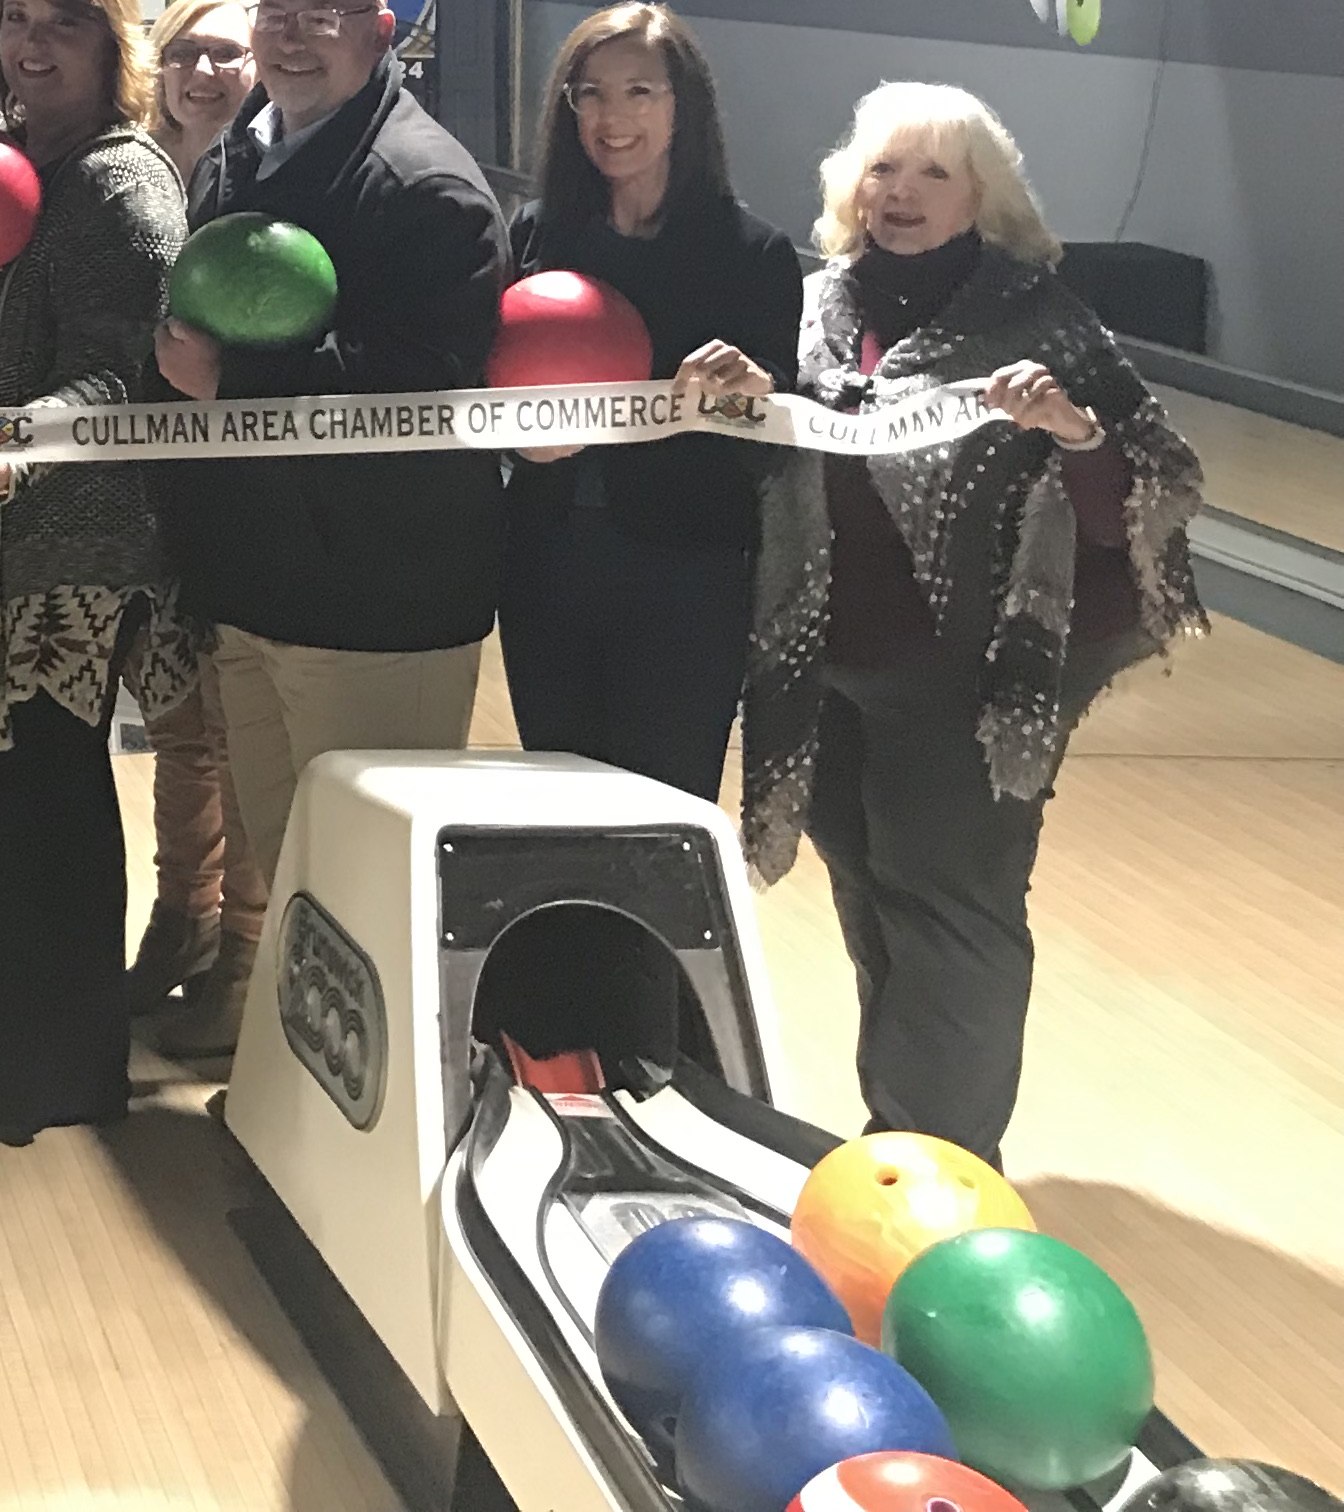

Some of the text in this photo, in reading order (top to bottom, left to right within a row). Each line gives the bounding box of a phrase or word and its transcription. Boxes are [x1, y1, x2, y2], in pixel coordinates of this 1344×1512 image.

[72, 411, 211, 447] CULLMAN
[221, 409, 299, 443] AREA
[310, 403, 455, 440] CHAMBER
[467, 400, 506, 434] OF
[517, 393, 686, 432] COMMERCE
